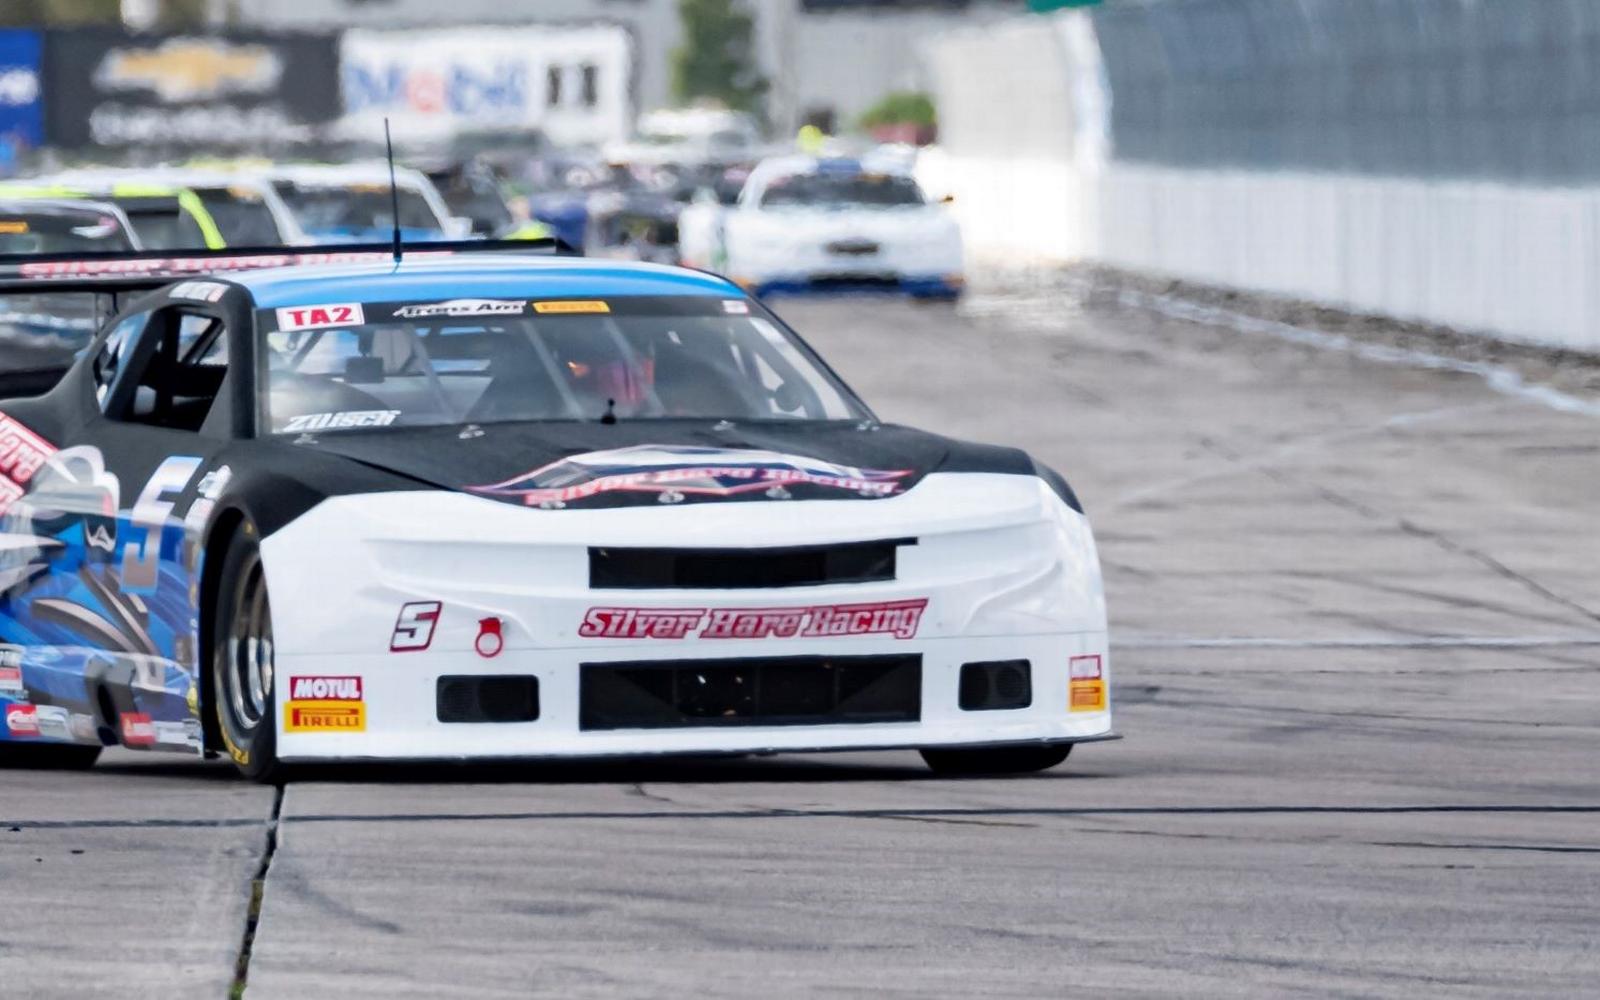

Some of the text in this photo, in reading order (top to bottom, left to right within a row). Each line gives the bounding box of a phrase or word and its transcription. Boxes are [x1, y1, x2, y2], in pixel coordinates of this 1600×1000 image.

[287, 307, 354, 326] TA2
[120, 455, 204, 594] 5
[390, 600, 443, 653] 5
[578, 598, 929, 640] Silver Hare Racing
[293, 678, 361, 699] MOTUL
[292, 708, 358, 726] PIRELLI
